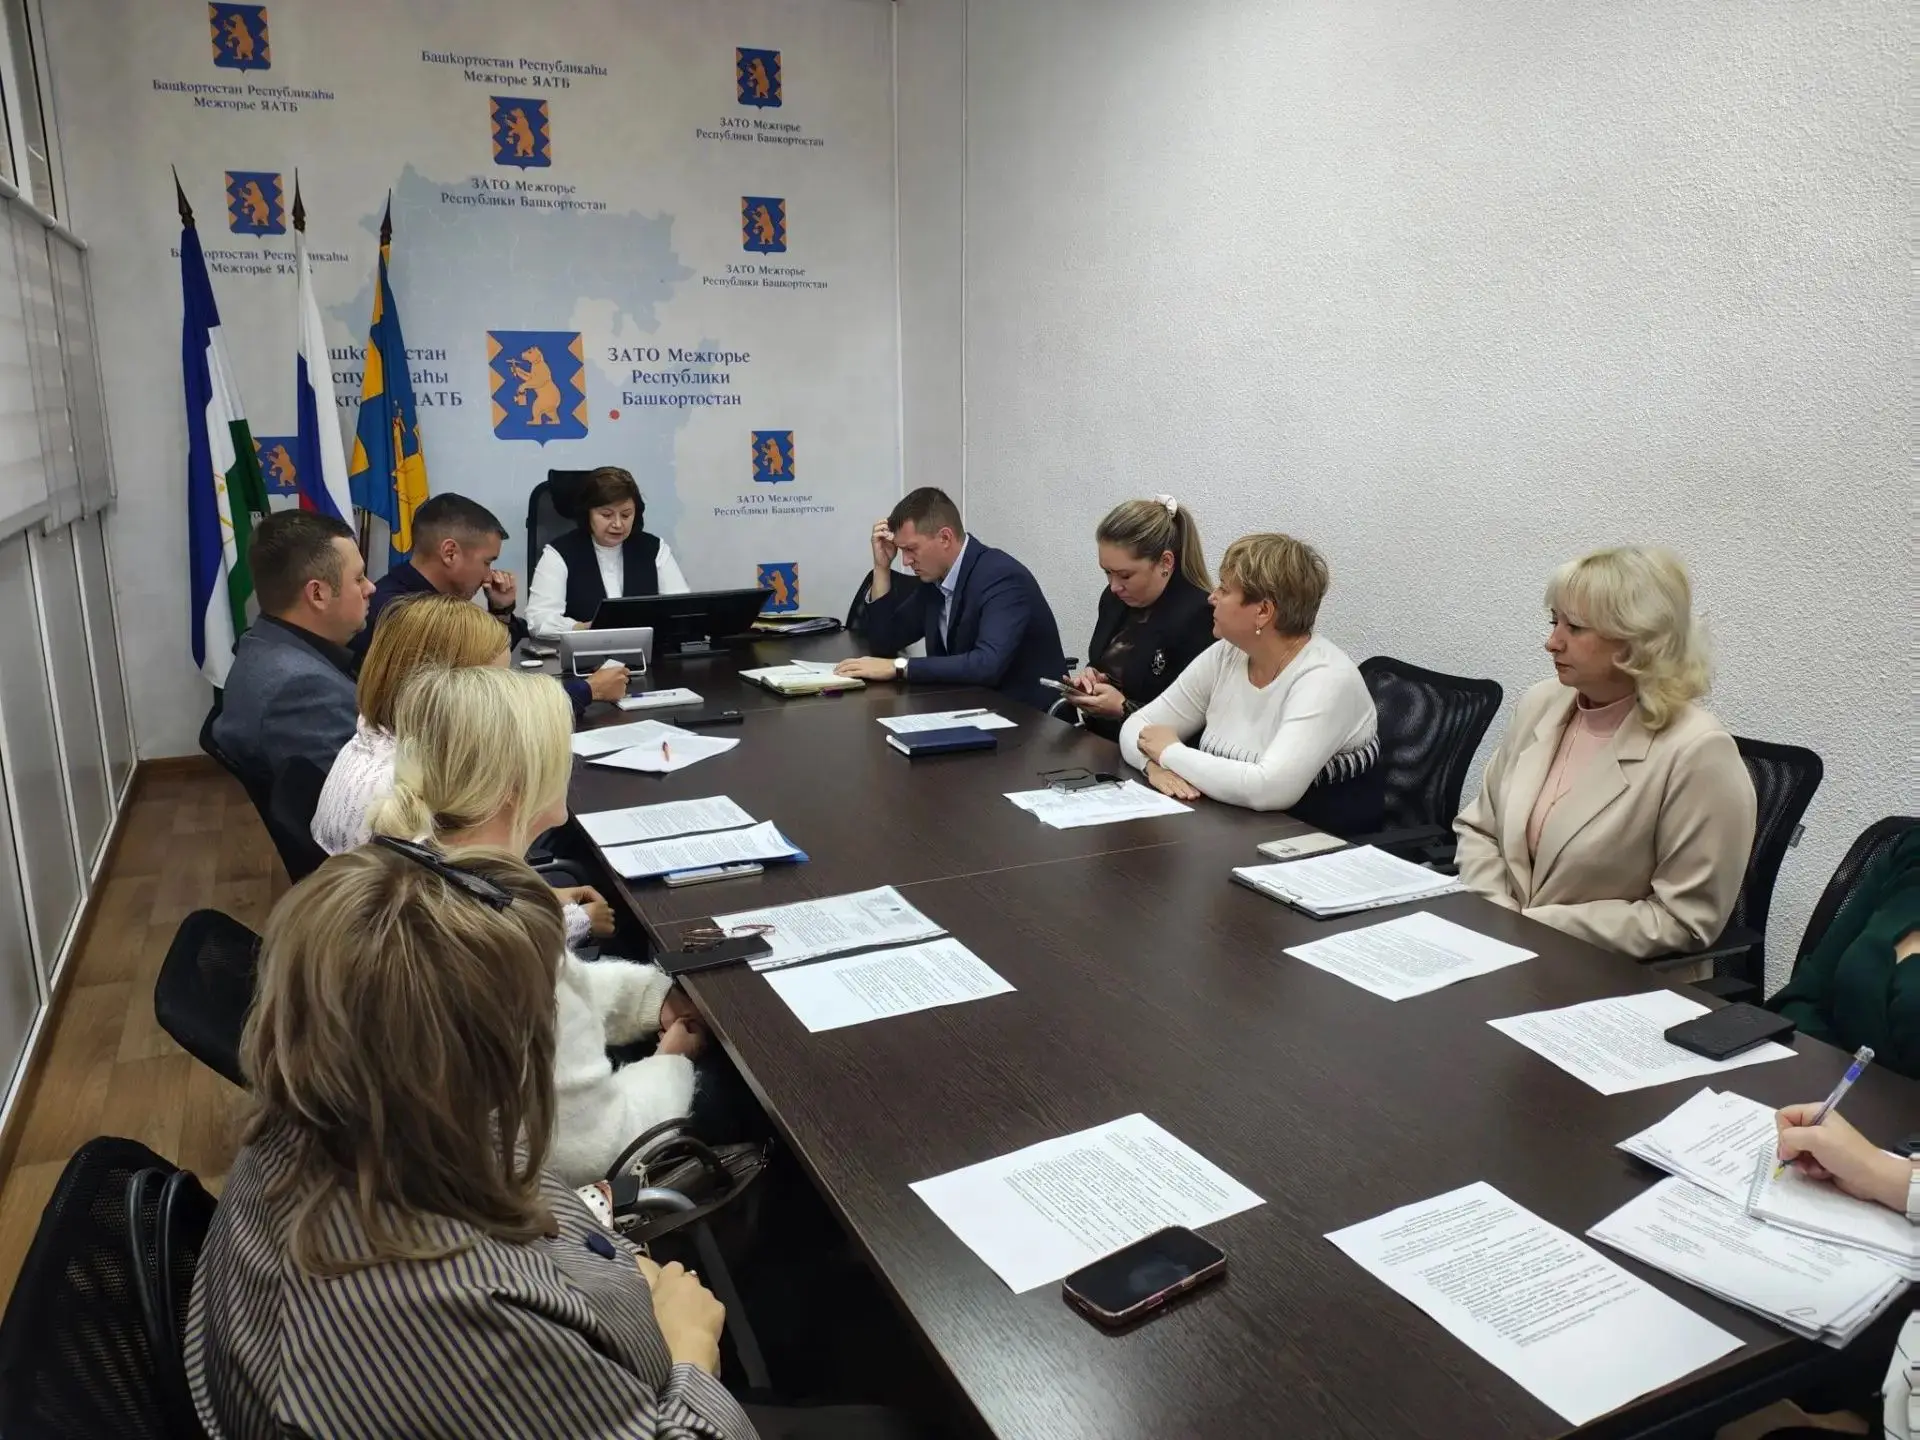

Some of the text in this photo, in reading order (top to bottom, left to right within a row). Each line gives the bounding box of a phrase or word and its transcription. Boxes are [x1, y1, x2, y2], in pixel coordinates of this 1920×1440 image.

[463, 70, 570, 89] Межгорье ЯАТБ
[193, 97, 299, 113] Межгорье ЯАТБ
[720, 116, 802, 134] ЗАТО Межгорье
[696, 128, 824, 147] Республики Башкортостан
[471, 177, 577, 195] ЗАТО Межгорье
[441, 192, 607, 211] Республики Башкортостан
[170, 248, 259, 262] Бортостан
[211, 263, 272, 276] Межгорье
[726, 264, 806, 278] ЗАТО Межгорье
[702, 276, 828, 290] Республики Башкортостан
[608, 347, 751, 366] ЗАТО Межгорье
[632, 368, 730, 387] Республики
[622, 391, 742, 408] Башкортостан
[736, 494, 813, 504] ЗАТО Межгорье
[714, 505, 835, 517] Республики Башкортостан
